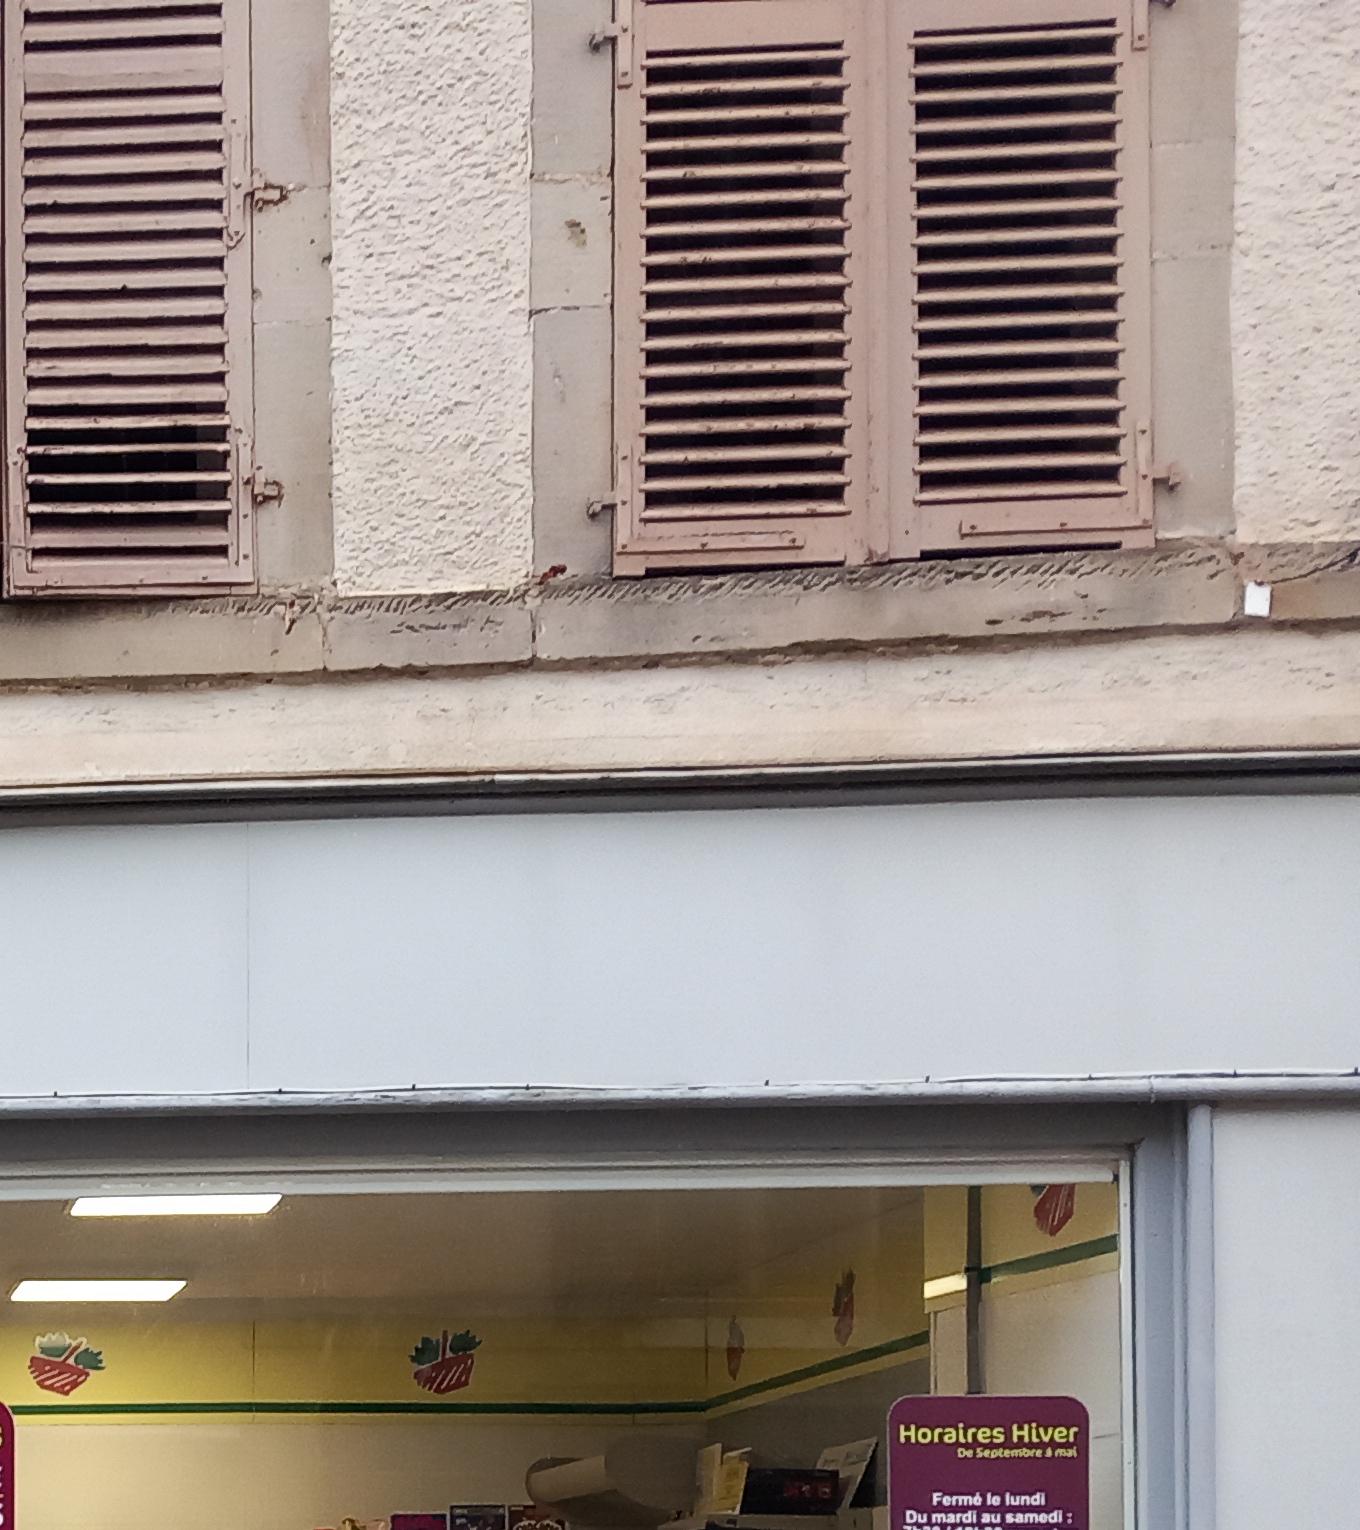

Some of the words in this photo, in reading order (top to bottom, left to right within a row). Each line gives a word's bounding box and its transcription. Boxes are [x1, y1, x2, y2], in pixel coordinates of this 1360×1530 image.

[899, 1423, 1005, 1443] Horaires
[1011, 1423, 1079, 1443] Hiver
[957, 1448, 971, 1458] De
[976, 1447, 1042, 1459] Septembre
[1055, 1446, 1077, 1458] mai
[932, 1491, 982, 1506] Fermé
[986, 1492, 1000, 1506] le
[1005, 1492, 1046, 1506] lundi
[905, 1510, 927, 1523] Du
[932, 1510, 977, 1523] mardi
[981, 1513, 1001, 1523] au
[1005, 1510, 1063, 1523] samedi
